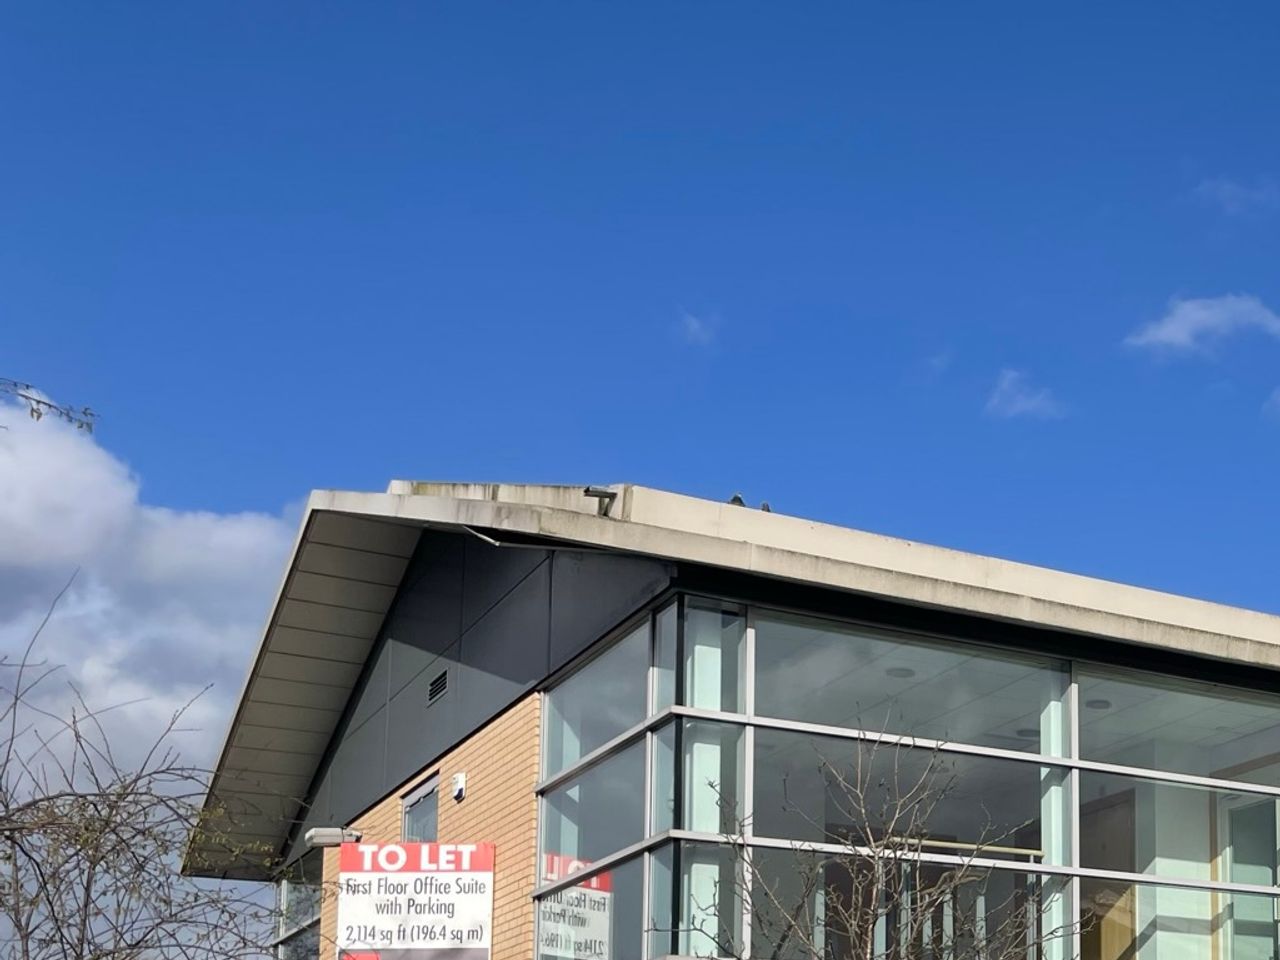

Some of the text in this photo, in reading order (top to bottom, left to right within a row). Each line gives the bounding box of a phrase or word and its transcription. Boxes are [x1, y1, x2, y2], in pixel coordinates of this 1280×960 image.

[358, 844, 477, 871] TO LET
[346, 876, 486, 895] First Floor Office Suite
[375, 898, 455, 918] with Parking
[346, 924, 484, 945] 2,114 sq ft (196.4 sq m)
